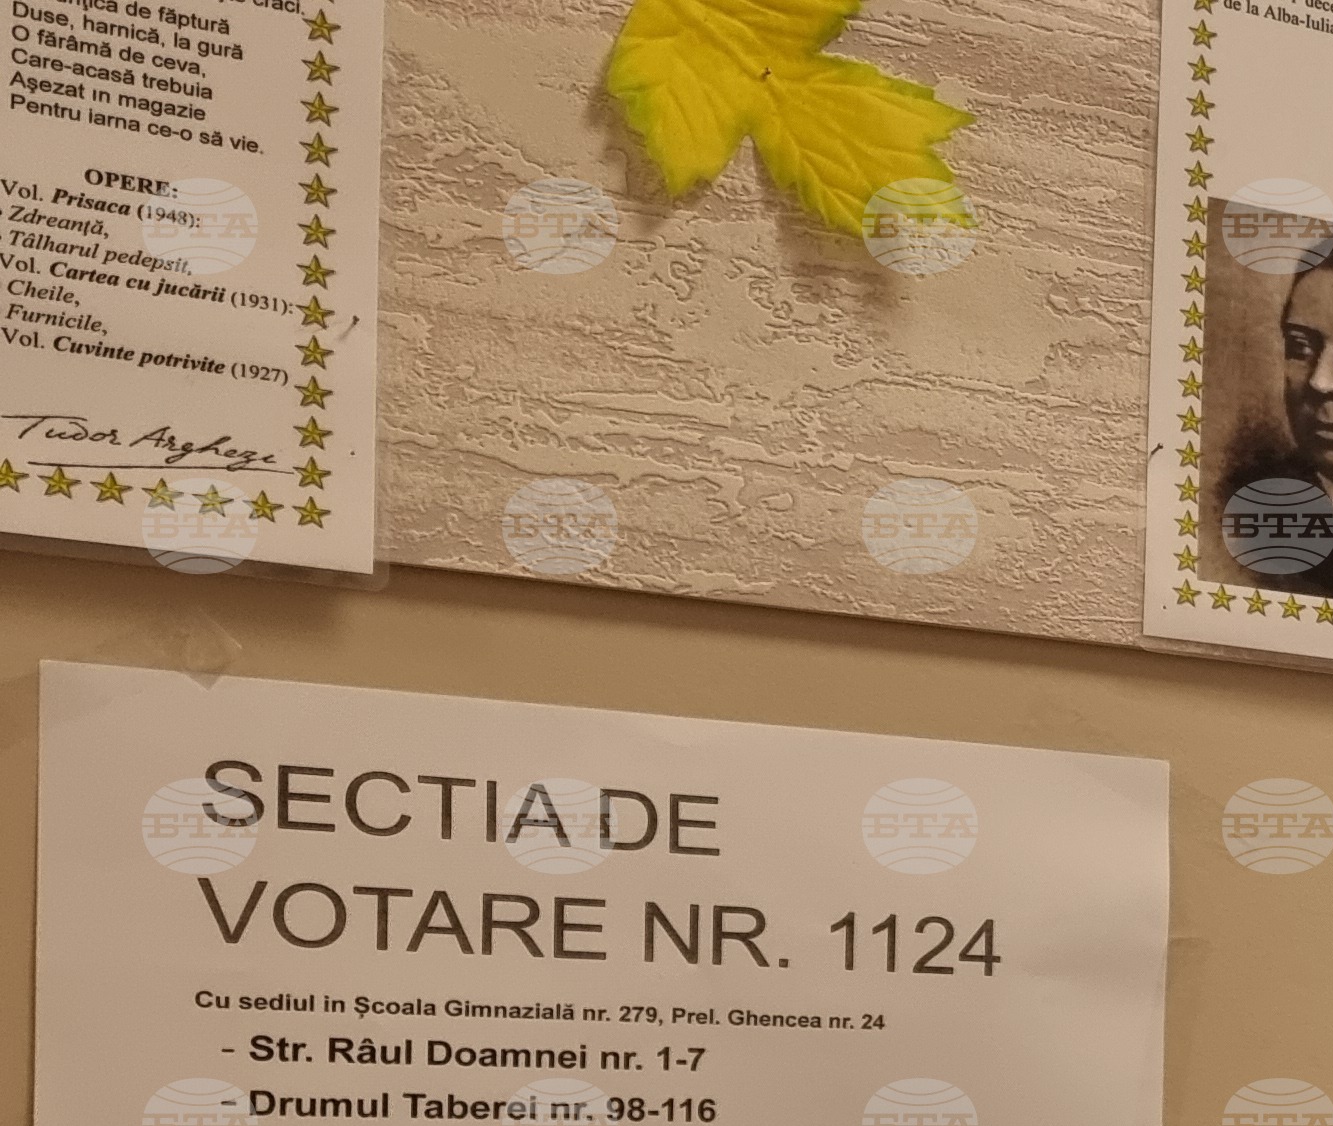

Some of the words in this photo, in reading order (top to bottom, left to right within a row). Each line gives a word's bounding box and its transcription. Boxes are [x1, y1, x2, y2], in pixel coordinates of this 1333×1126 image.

[13, 0, 74, 31] Duse,
[83, 15, 165, 48] harnică,
[174, 32, 190, 51] la
[197, 41, 243, 60] gură
[125, 1, 151, 19] de
[158, 6, 229, 35] făptură
[11, 24, 30, 42] O
[37, 29, 112, 58] fărâmă
[119, 46, 145, 64] de
[152, 55, 205, 78] ceva,
[11, 47, 135, 85] Care-acasă
[142, 73, 213, 100] trebuia
[10, 93, 81, 122] Pentru
[89, 108, 140, 132] iarna
[147, 123, 193, 141] ce-o
[199, 131, 223, 147] să
[229, 135, 264, 155] vie.
[118, 94, 206, 121] magazie
[84, 168, 178, 199] OPERE:
[51, 188, 131, 216] Prisaca
[137, 204, 200, 229] (1948):
[9, 230, 100, 259] Tâlharul
[101, 250, 191, 276] pedepsit,
[7, 279, 80, 308] Cheile,
[49, 261, 120, 286] Cartea
[126, 278, 151, 291] cu
[152, 278, 226, 303] jucării
[231, 292, 294, 316] (1931):
[5, 303, 107, 336] Furnicile,
[53, 336, 135, 361] Cuvinte
[137, 352, 226, 374] potrivite
[231, 363, 288, 386] (1927)
[202, 760, 571, 847] SECTIA
[600, 789, 720, 856] DE
[197, 877, 606, 960] VOTARE
[644, 902, 789, 968] NR.
[831, 912, 1001, 976] 1124
[195, 990, 230, 1009] Cu
[239, 993, 315, 1012] sediul
[324, 995, 345, 1013] in
[444, 999, 575, 1020] Gimnazială
[583, 1007, 611, 1021] nr.
[619, 1006, 664, 1026] 279,
[672, 1007, 720, 1025] Prel.
[728, 1009, 822, 1028] Ghencea
[829, 1017, 854, 1029] nr.
[861, 1014, 885, 1030] 24
[249, 1035, 312, 1062] Str.
[329, 1037, 412, 1065] Râul
[428, 1040, 587, 1069] Doamnei
[601, 1051, 643, 1070] nr.
[657, 1046, 706, 1071] 1-7
[249, 1090, 389, 1118] Drumul
[402, 1092, 538, 1120] Taberei
[551, 1102, 595, 1121] nr.
[607, 1097, 717, 1123] 98-116
